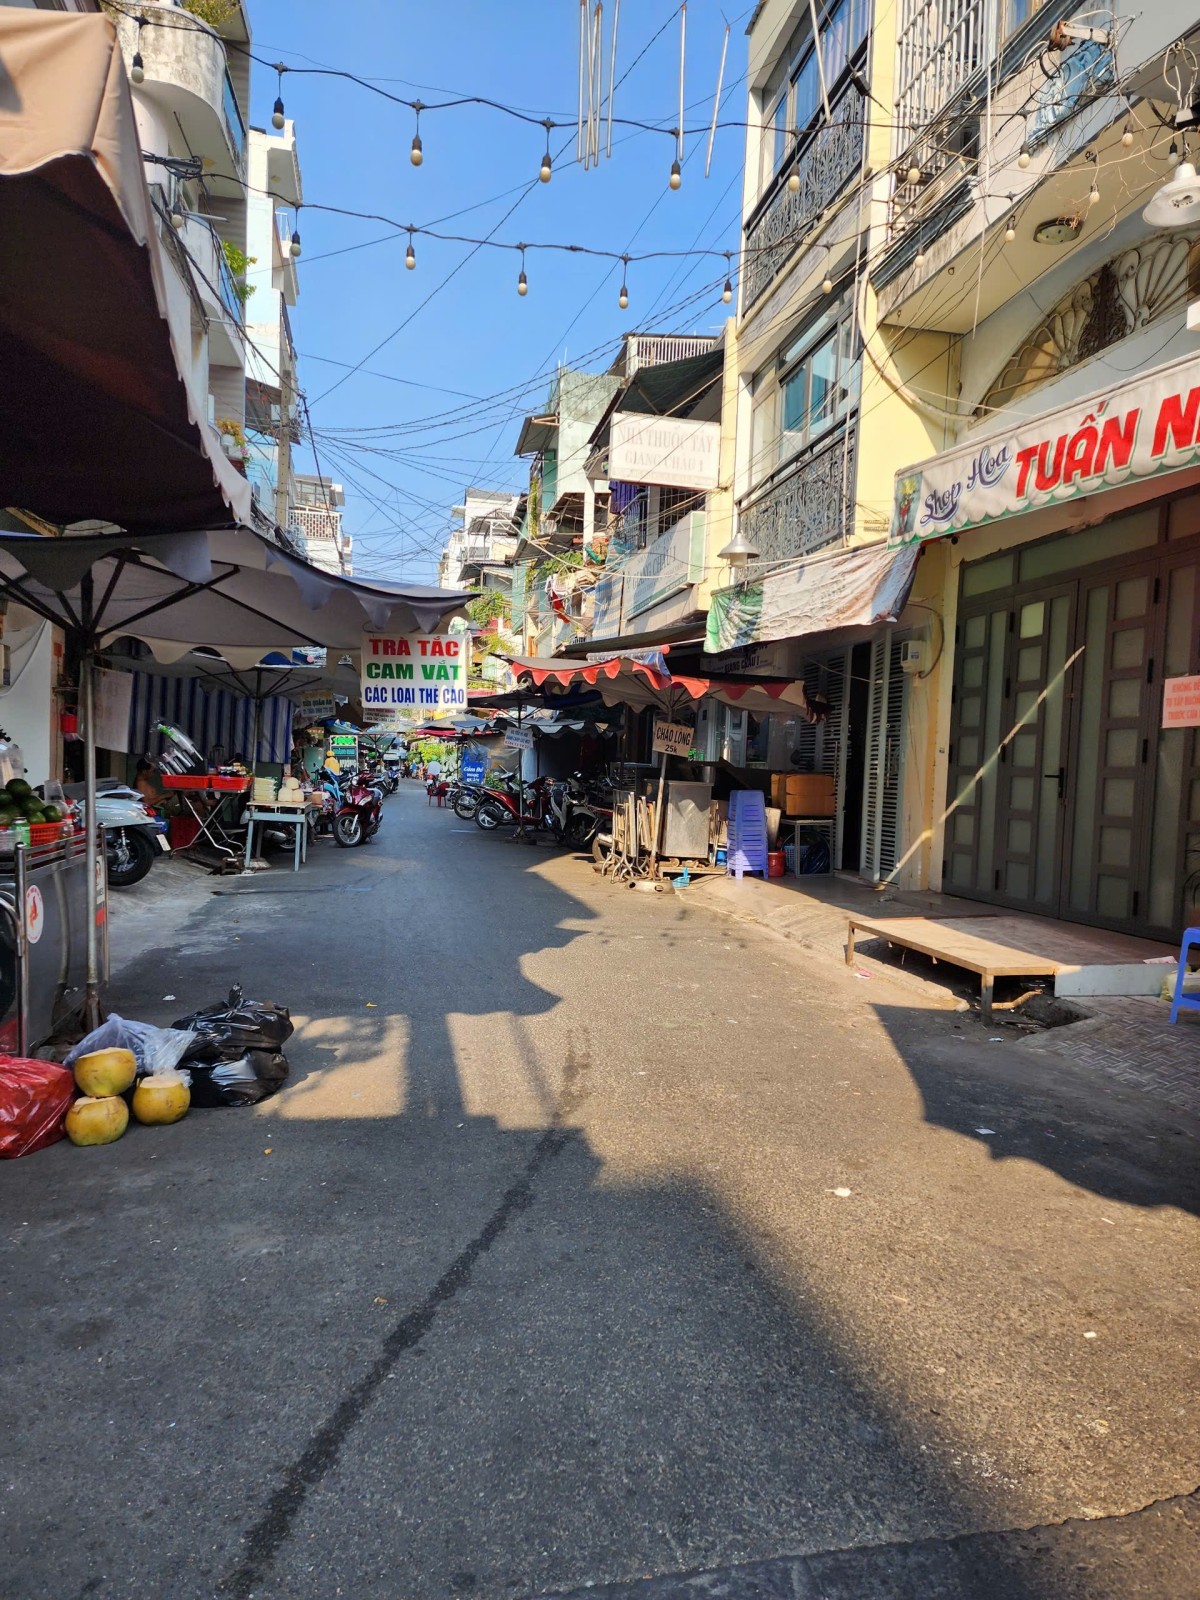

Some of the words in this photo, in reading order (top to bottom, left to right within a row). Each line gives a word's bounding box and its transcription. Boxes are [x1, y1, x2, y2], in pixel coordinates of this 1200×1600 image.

[1016, 401, 1141, 498] TUẤN
[1151, 386, 1200, 461] N
[920, 481, 962, 526] Shop
[967, 445, 1013, 491] Hoa
[369, 636, 411, 656] TRÀ
[417, 636, 459, 656] TẮC
[366, 663, 413, 680] CAM
[421, 660, 462, 680] VẮT
[365, 684, 388, 703] CÁC
[391, 687, 415, 706] LOẠI
[419, 685, 439, 704] THẺ
[656, 726, 674, 742] CHÁO
[674, 728, 691, 746] LÒNG
